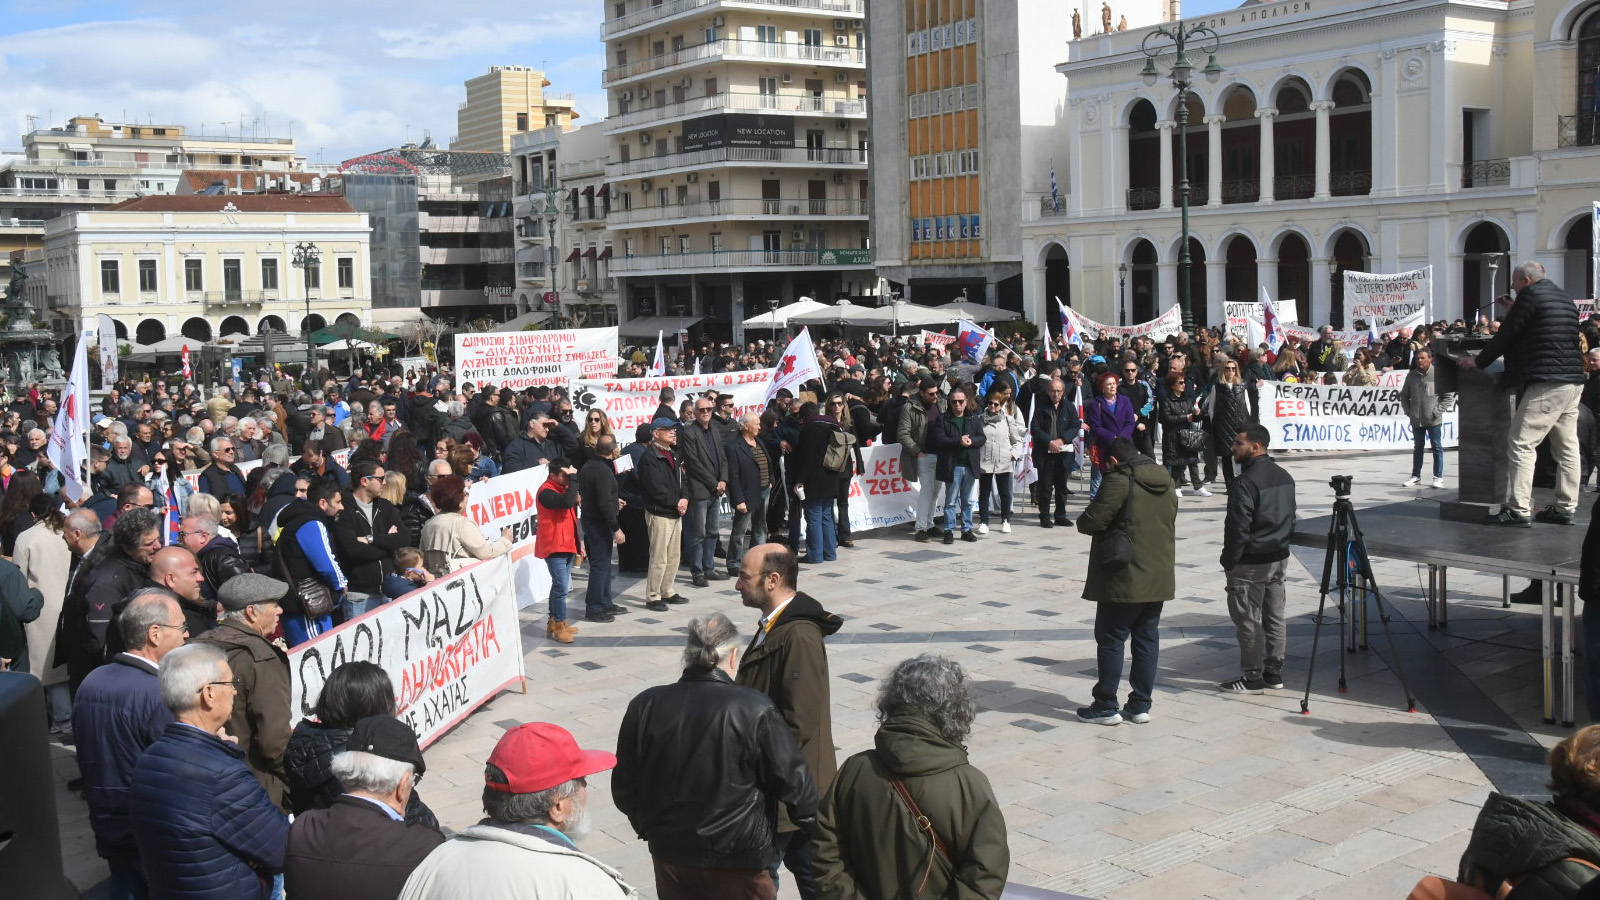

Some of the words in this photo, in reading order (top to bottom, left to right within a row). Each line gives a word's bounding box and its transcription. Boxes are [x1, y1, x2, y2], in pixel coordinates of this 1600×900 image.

[1241, 2, 1310, 23] ΑΠΟΛΛΩΝ
[754, 128, 786, 136] LOCATION
[462, 336, 505, 347] ΔΗΜΟΣΙΟΙ
[509, 333, 576, 346] ΣΙΔΗΡΟΔΡΟΜΟΙ
[463, 368, 497, 379] ΦΥΓΕΤΕ
[604, 382, 623, 392] ΤΑ
[671, 377, 701, 390] ΤΟΥΣ
[738, 372, 769, 384] ΖΩΕΣ
[1274, 384, 1320, 400] ΛΕΦΤΑ
[1327, 388, 1352, 401] ΓΙΑ
[1358, 389, 1400, 402] ΜΙΣΘ
[604, 395, 662, 412] ΥΠΟΓΡΑ
[1275, 400, 1306, 418] ΕΞΩ
[1322, 402, 1377, 416] ΕΛΛΑΔΑ
[1380, 403, 1400, 416] ΑΠ
[1282, 423, 1352, 443] ΣΥΛΛΟΓΟΣ
[866, 477, 912, 495] ΖΩΕΣ
[400, 572, 484, 661] ΜΑΖΙ
